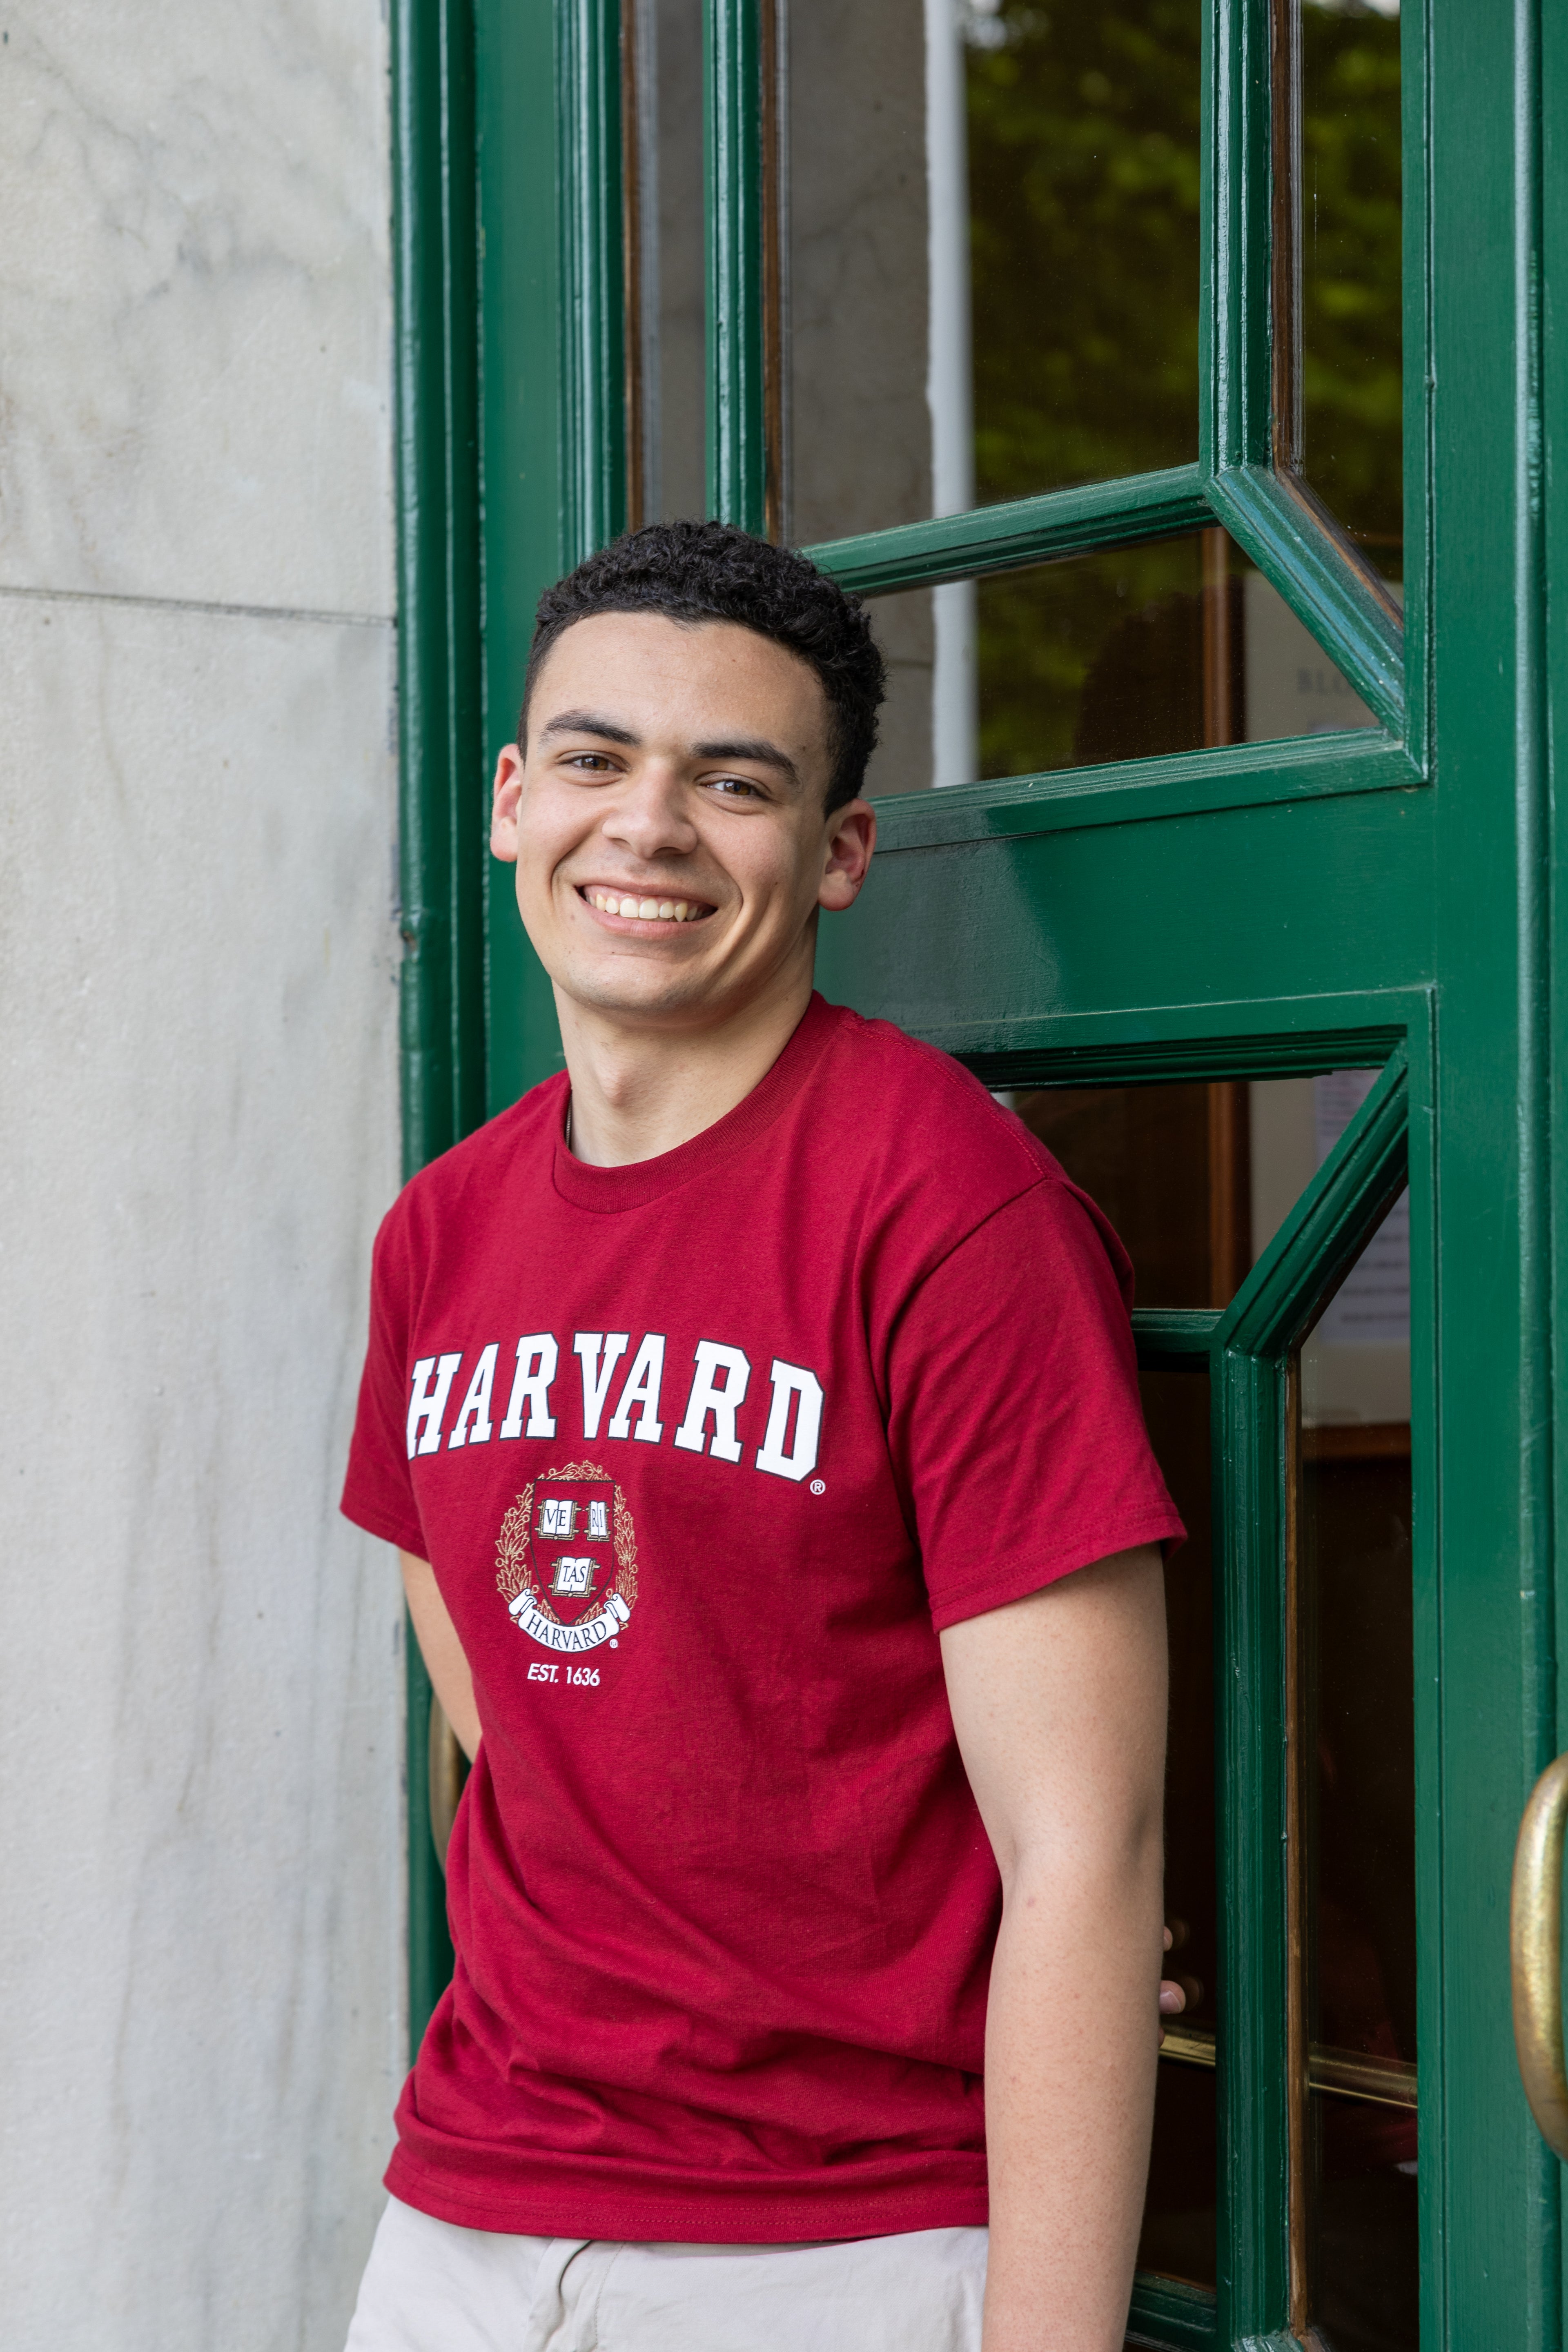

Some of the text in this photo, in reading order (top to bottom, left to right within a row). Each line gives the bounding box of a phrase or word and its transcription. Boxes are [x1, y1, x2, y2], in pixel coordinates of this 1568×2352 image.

[406, 1332, 825, 1483] HARVARD
[545, 1509, 603, 1528] VE RI
[563, 1566, 586, 1583] TAS
[526, 1613, 607, 1650] HARVARD
[527, 1663, 600, 1686] EST. 1636
